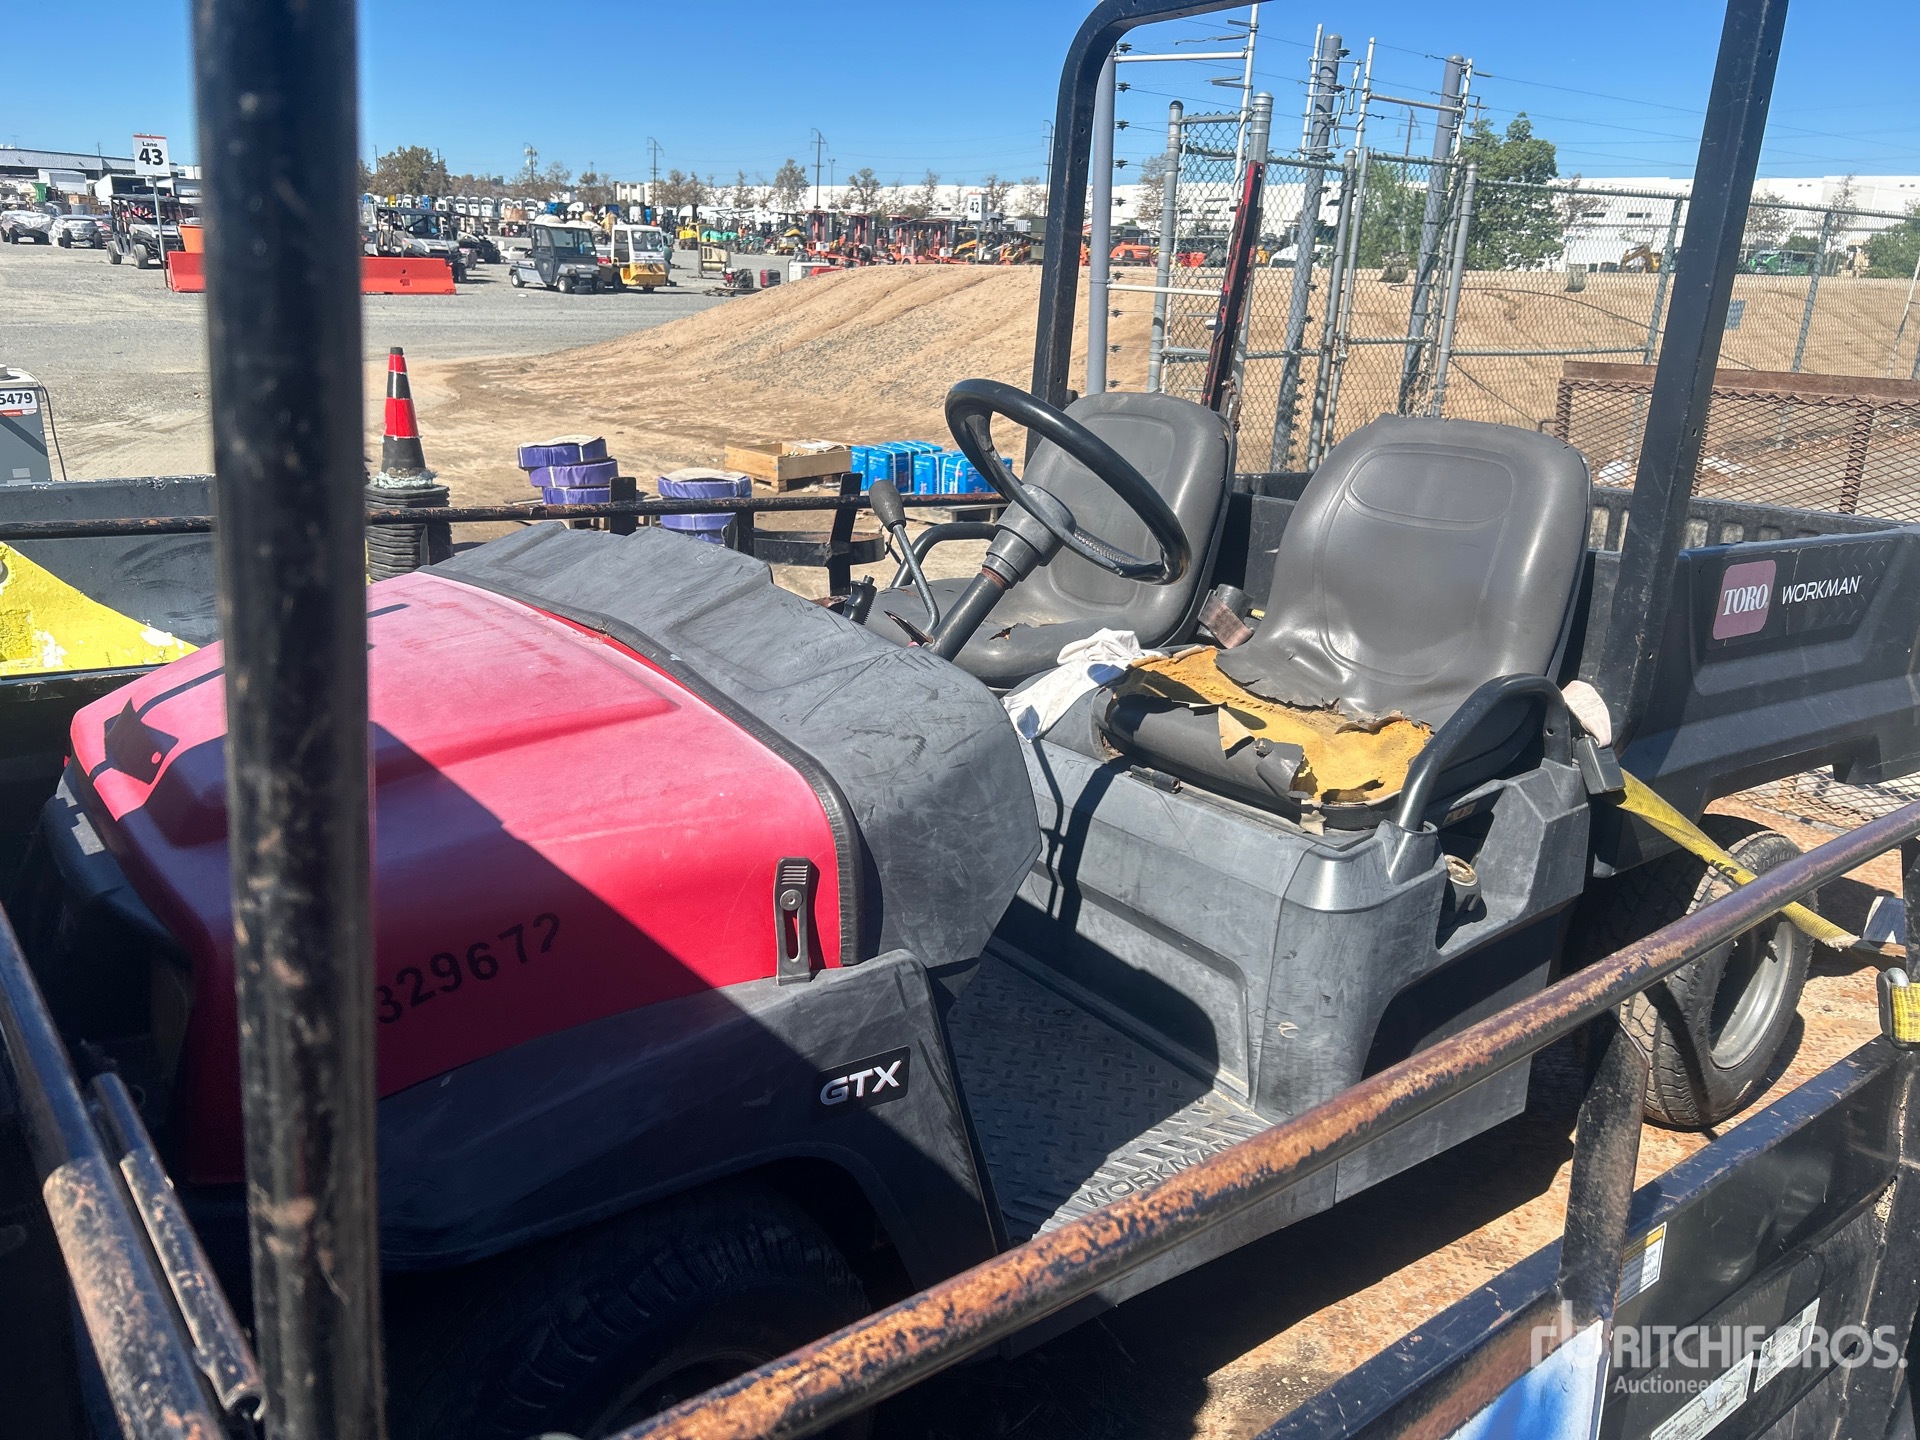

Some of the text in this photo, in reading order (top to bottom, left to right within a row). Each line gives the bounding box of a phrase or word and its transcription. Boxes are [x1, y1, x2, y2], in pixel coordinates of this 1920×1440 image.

[139, 148, 164, 165] 43
[970, 202, 980, 213] 42
[0, 392, 33, 405] 5479
[1722, 583, 1768, 616] TORO
[1781, 575, 1861, 605] WORKMAN
[820, 1060, 902, 1105] GTX
